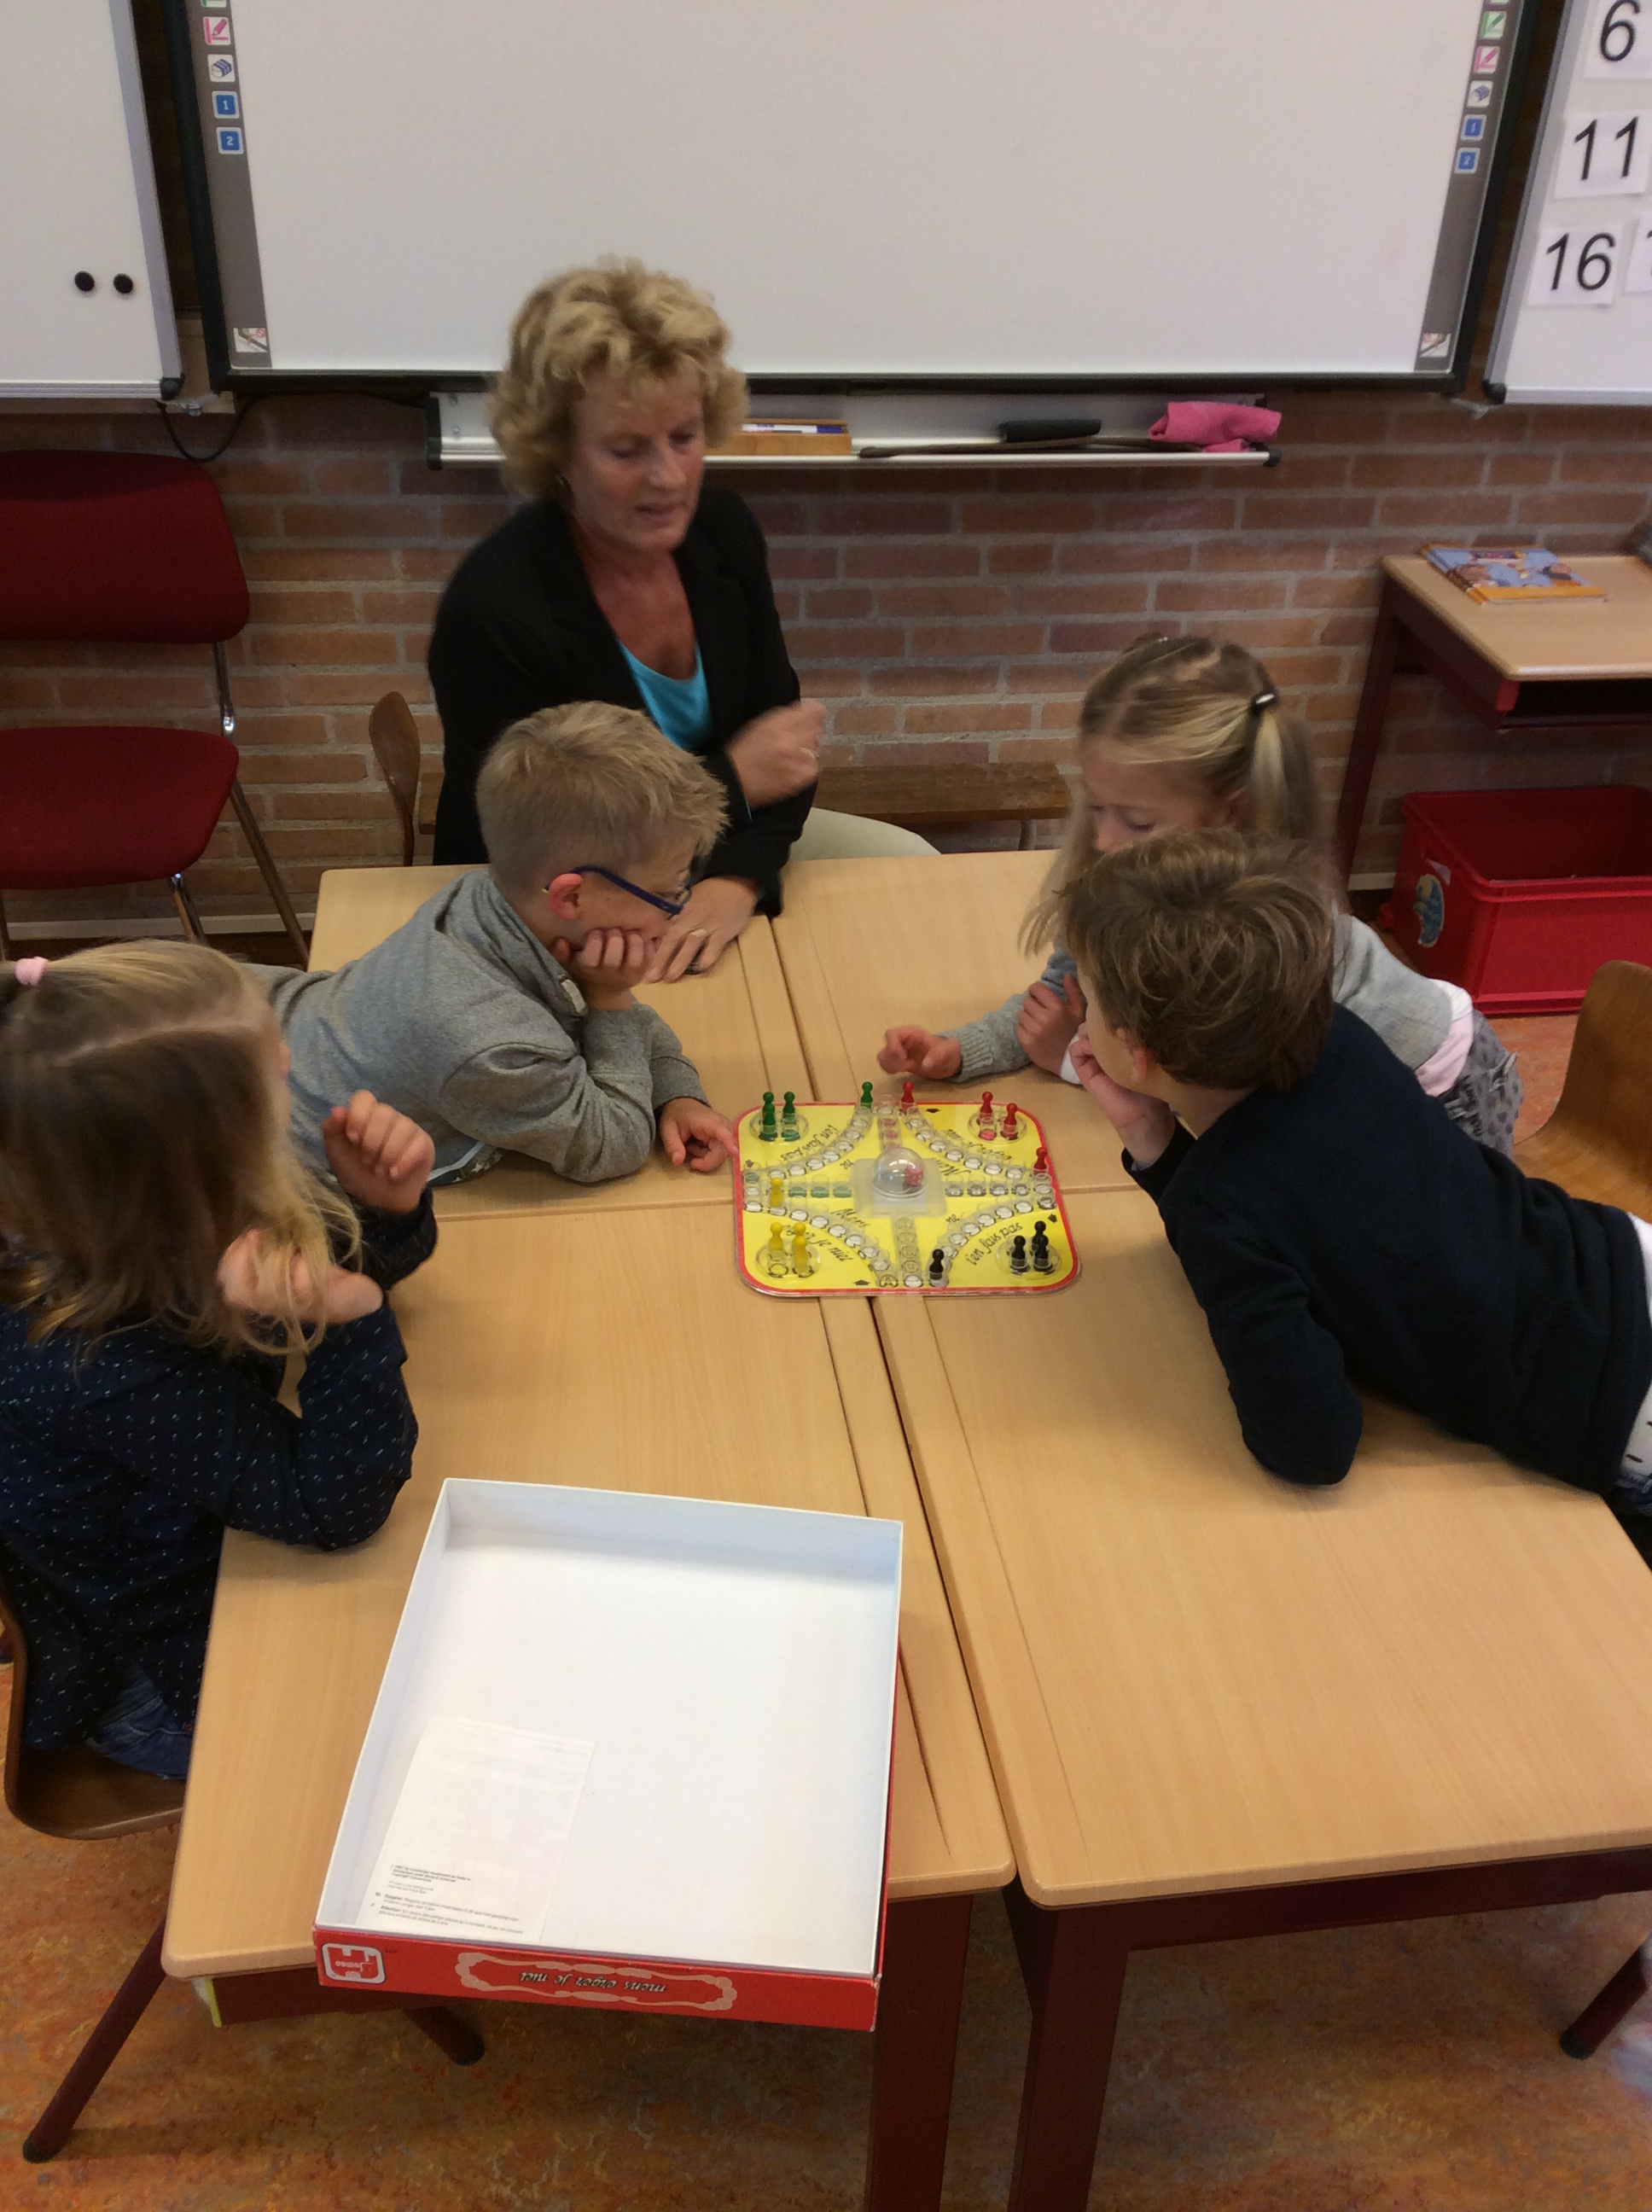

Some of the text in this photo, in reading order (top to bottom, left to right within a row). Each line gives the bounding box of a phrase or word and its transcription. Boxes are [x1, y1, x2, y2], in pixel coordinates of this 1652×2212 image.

[1600, 0, 1641, 61] 6
[223, 100, 229, 110] 1
[226, 136, 234, 146] 2
[1573, 116, 1638, 180] 11
[1546, 232, 1616, 291] 16
[998, 1221, 1023, 1240] pas
[554, 1972, 573, 1987] je
[574, 1975, 618, 1989] erger
[624, 1981, 666, 1994] mens
